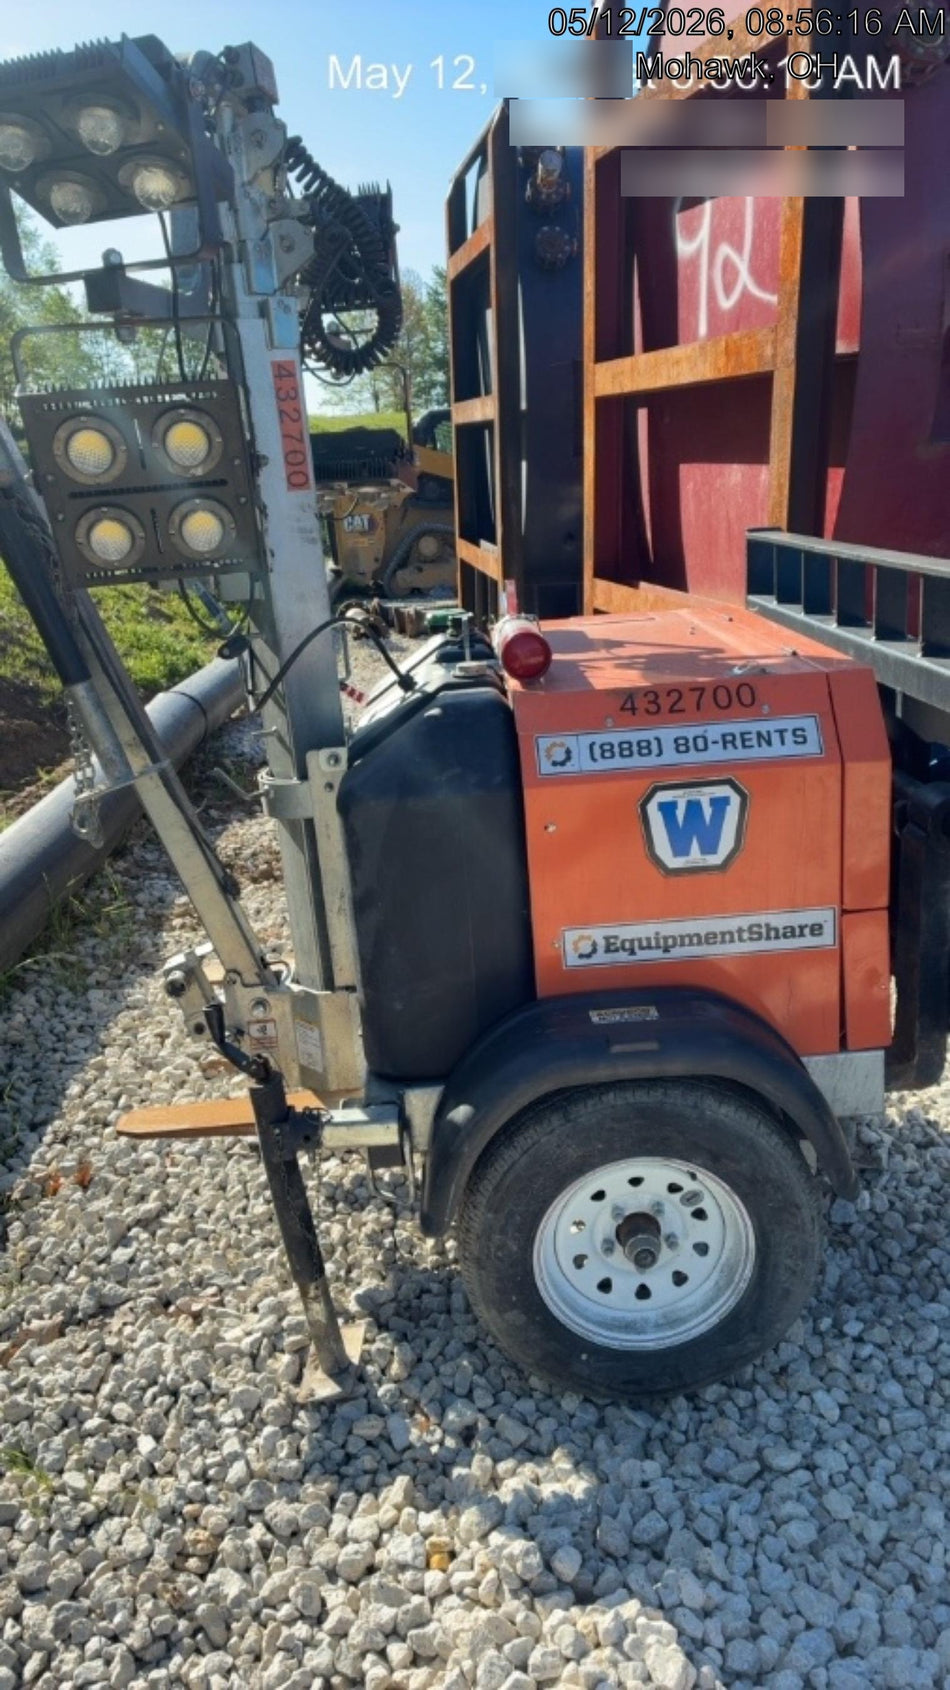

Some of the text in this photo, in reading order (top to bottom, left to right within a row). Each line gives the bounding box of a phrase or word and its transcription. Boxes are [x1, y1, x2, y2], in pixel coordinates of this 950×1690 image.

[274, 363, 309, 488] 432700
[344, 514, 369, 531] CAT
[619, 682, 756, 716] 432700
[588, 727, 808, 763] (888) 80-RENTS
[657, 796, 731, 858] W
[602, 922, 825, 957] EquipmentShare
